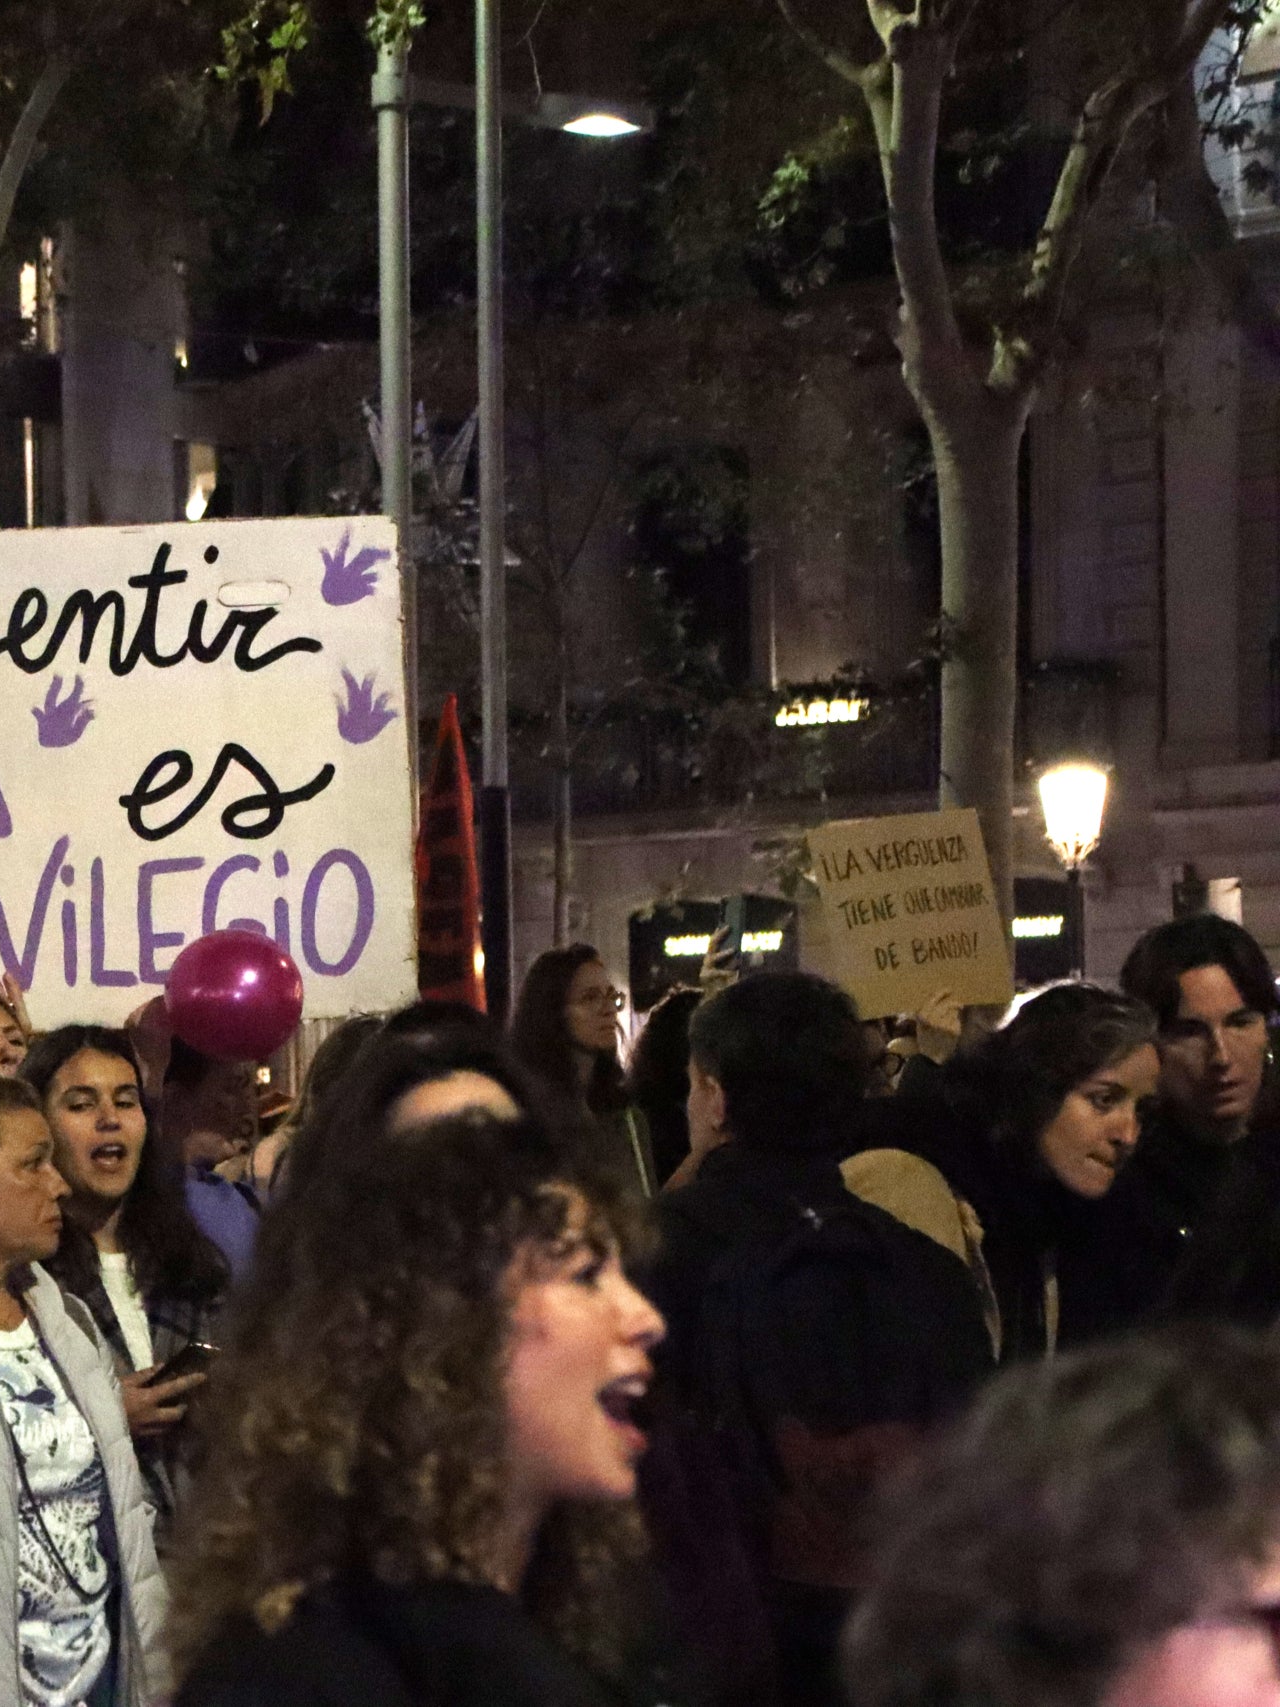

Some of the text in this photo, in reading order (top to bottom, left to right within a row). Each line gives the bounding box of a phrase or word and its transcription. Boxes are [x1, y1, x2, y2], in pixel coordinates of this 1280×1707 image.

[119, 743, 335, 841] es
[838, 893, 897, 930] TIENE
[874, 932, 978, 971] DE BANDO!
